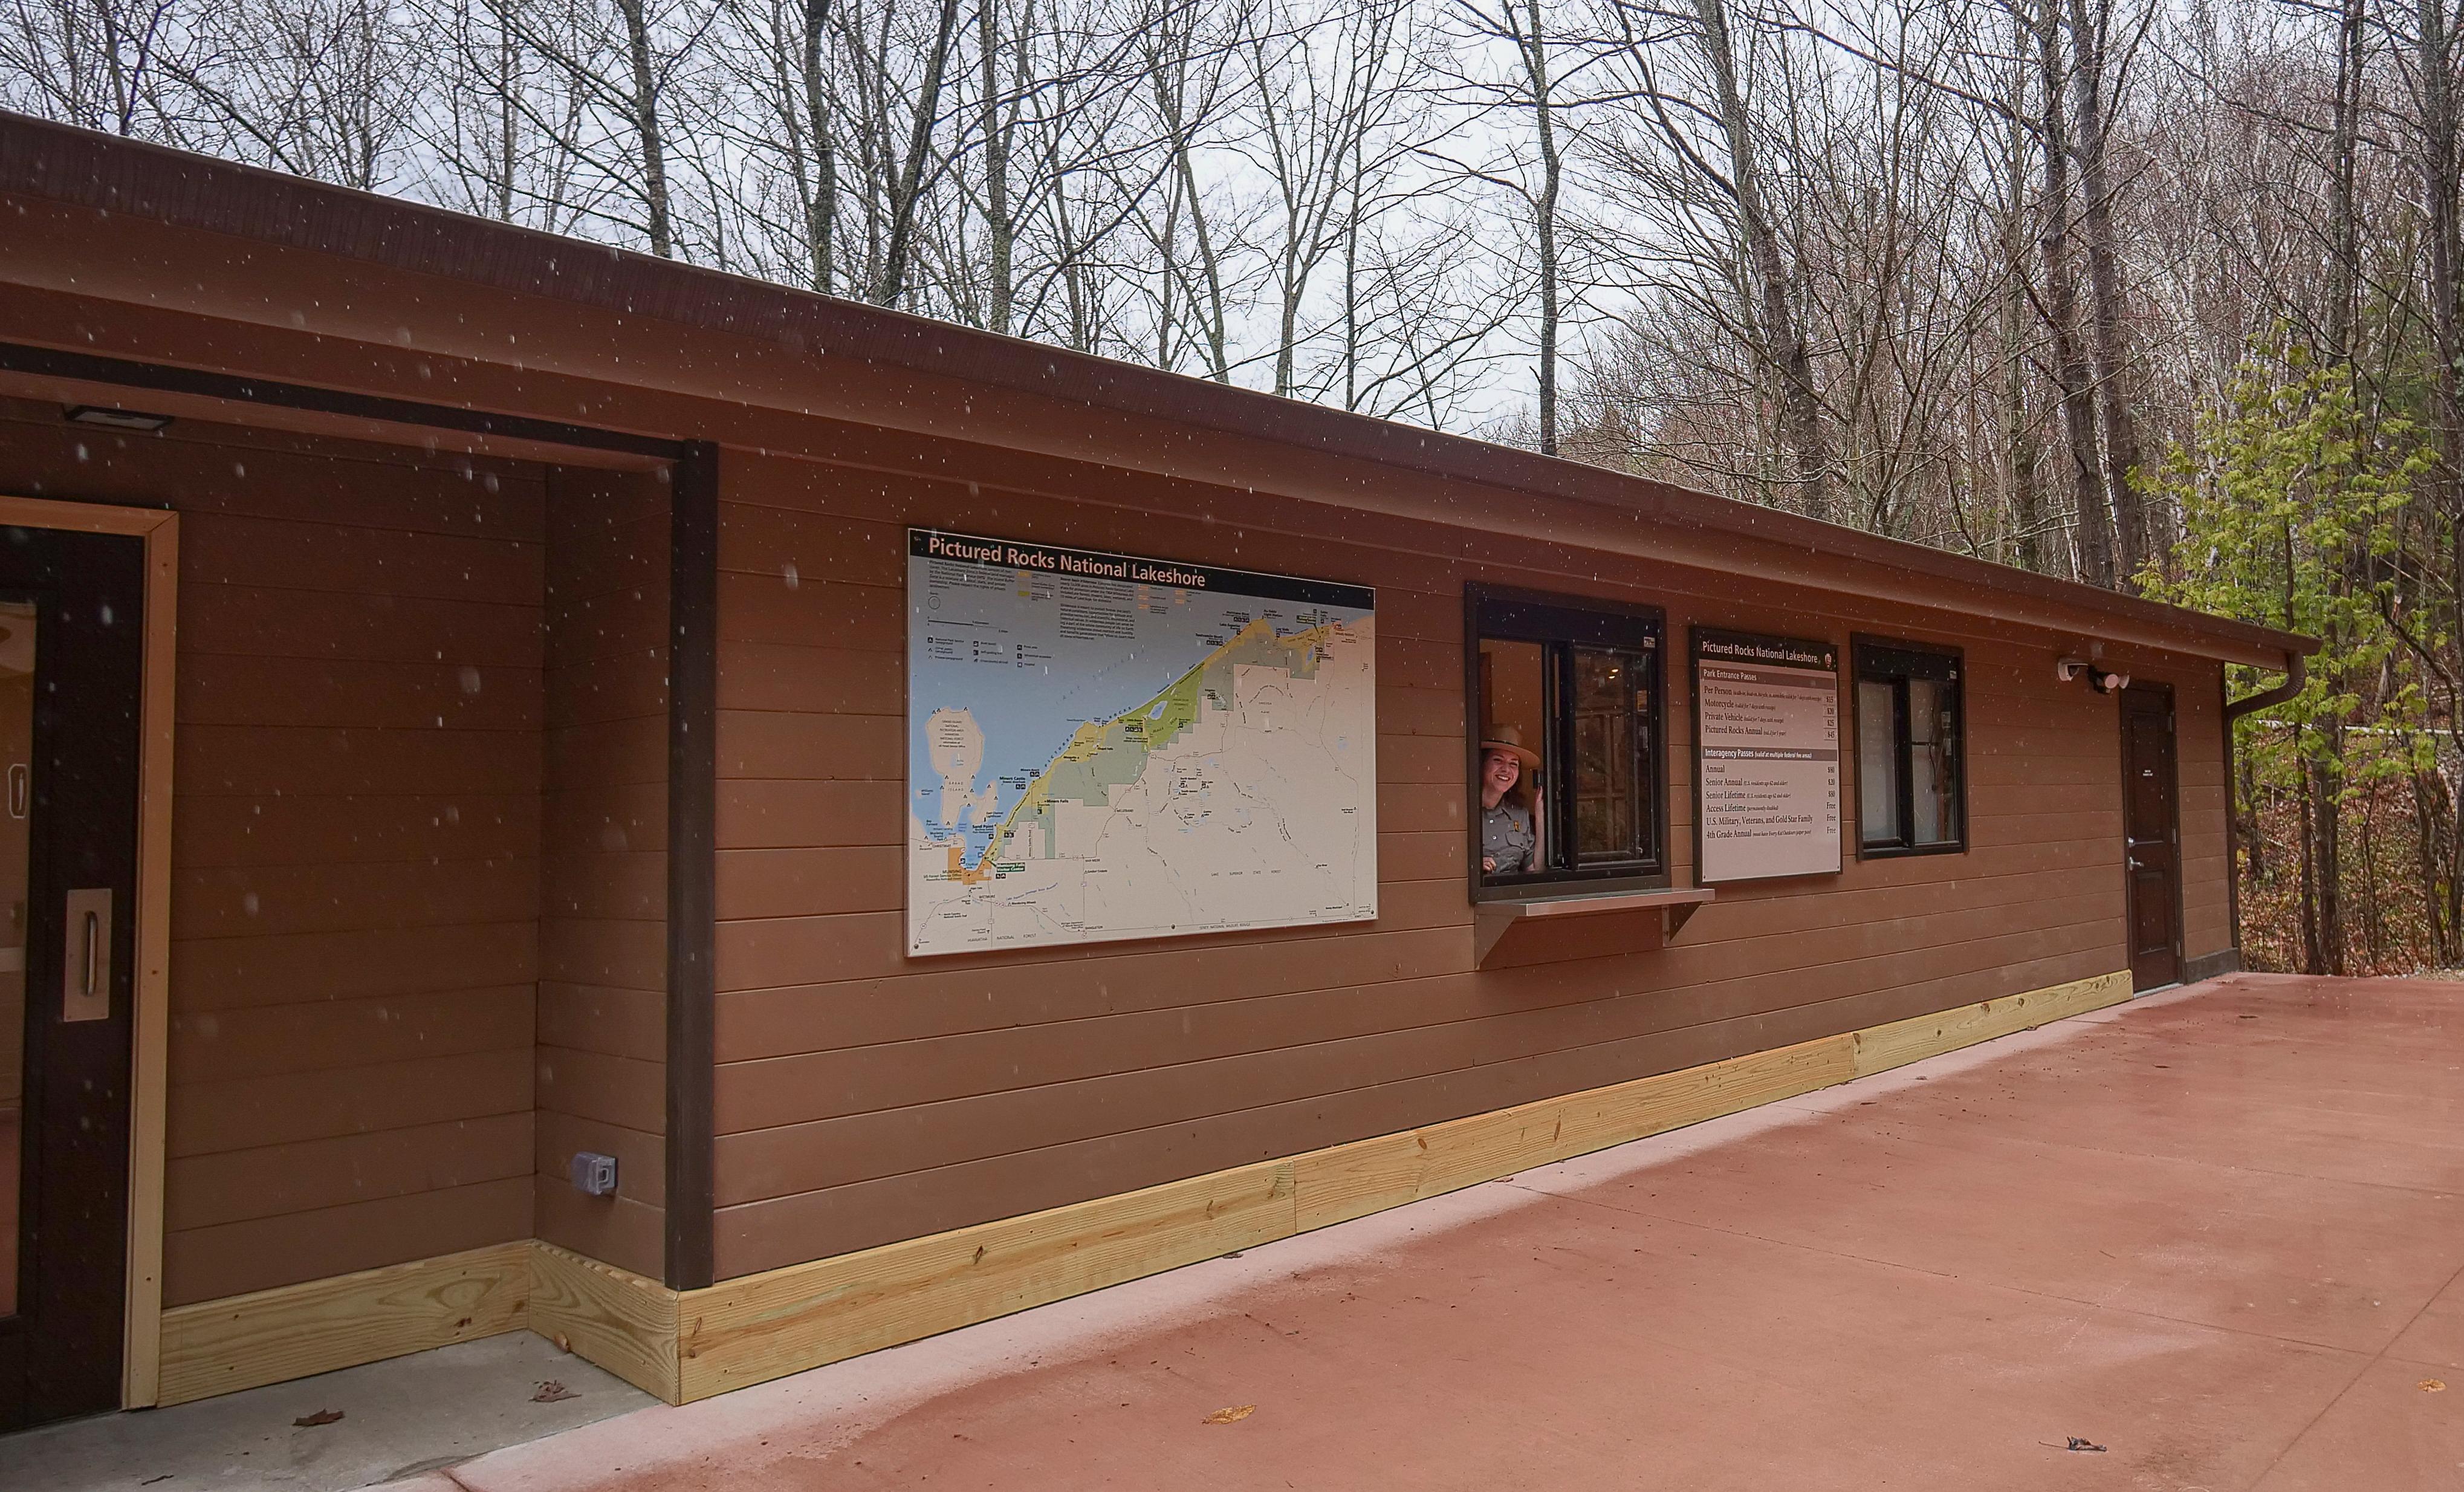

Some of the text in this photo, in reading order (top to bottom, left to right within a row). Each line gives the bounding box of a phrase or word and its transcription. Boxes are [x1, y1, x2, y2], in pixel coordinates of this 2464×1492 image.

[929, 537, 1205, 586] Pictured Rocks National Lakeshore
[1702, 641, 1818, 663] Pictured Rocks National Lakeshore
[1717, 670, 1740, 680] Entrance
[1705, 699, 1734, 710] Motorcycle
[1705, 712, 1724, 721] Private
[1725, 713, 1743, 721] Vehicle
[1705, 725, 1727, 734] Pictured
[1705, 748, 1737, 759] Interagency
[1706, 791, 1723, 799] Senior
[1706, 804, 1723, 812] Access
[1725, 803, 1746, 812] Lifetime
[1719, 817, 1741, 826] Military,
[1742, 816, 1765, 825] Veterans,
[1798, 814, 1813, 823] Family
[1707, 831, 1716, 839] 4th
[1716, 830, 1733, 838] Grade
[1733, 829, 1752, 838] Annual
